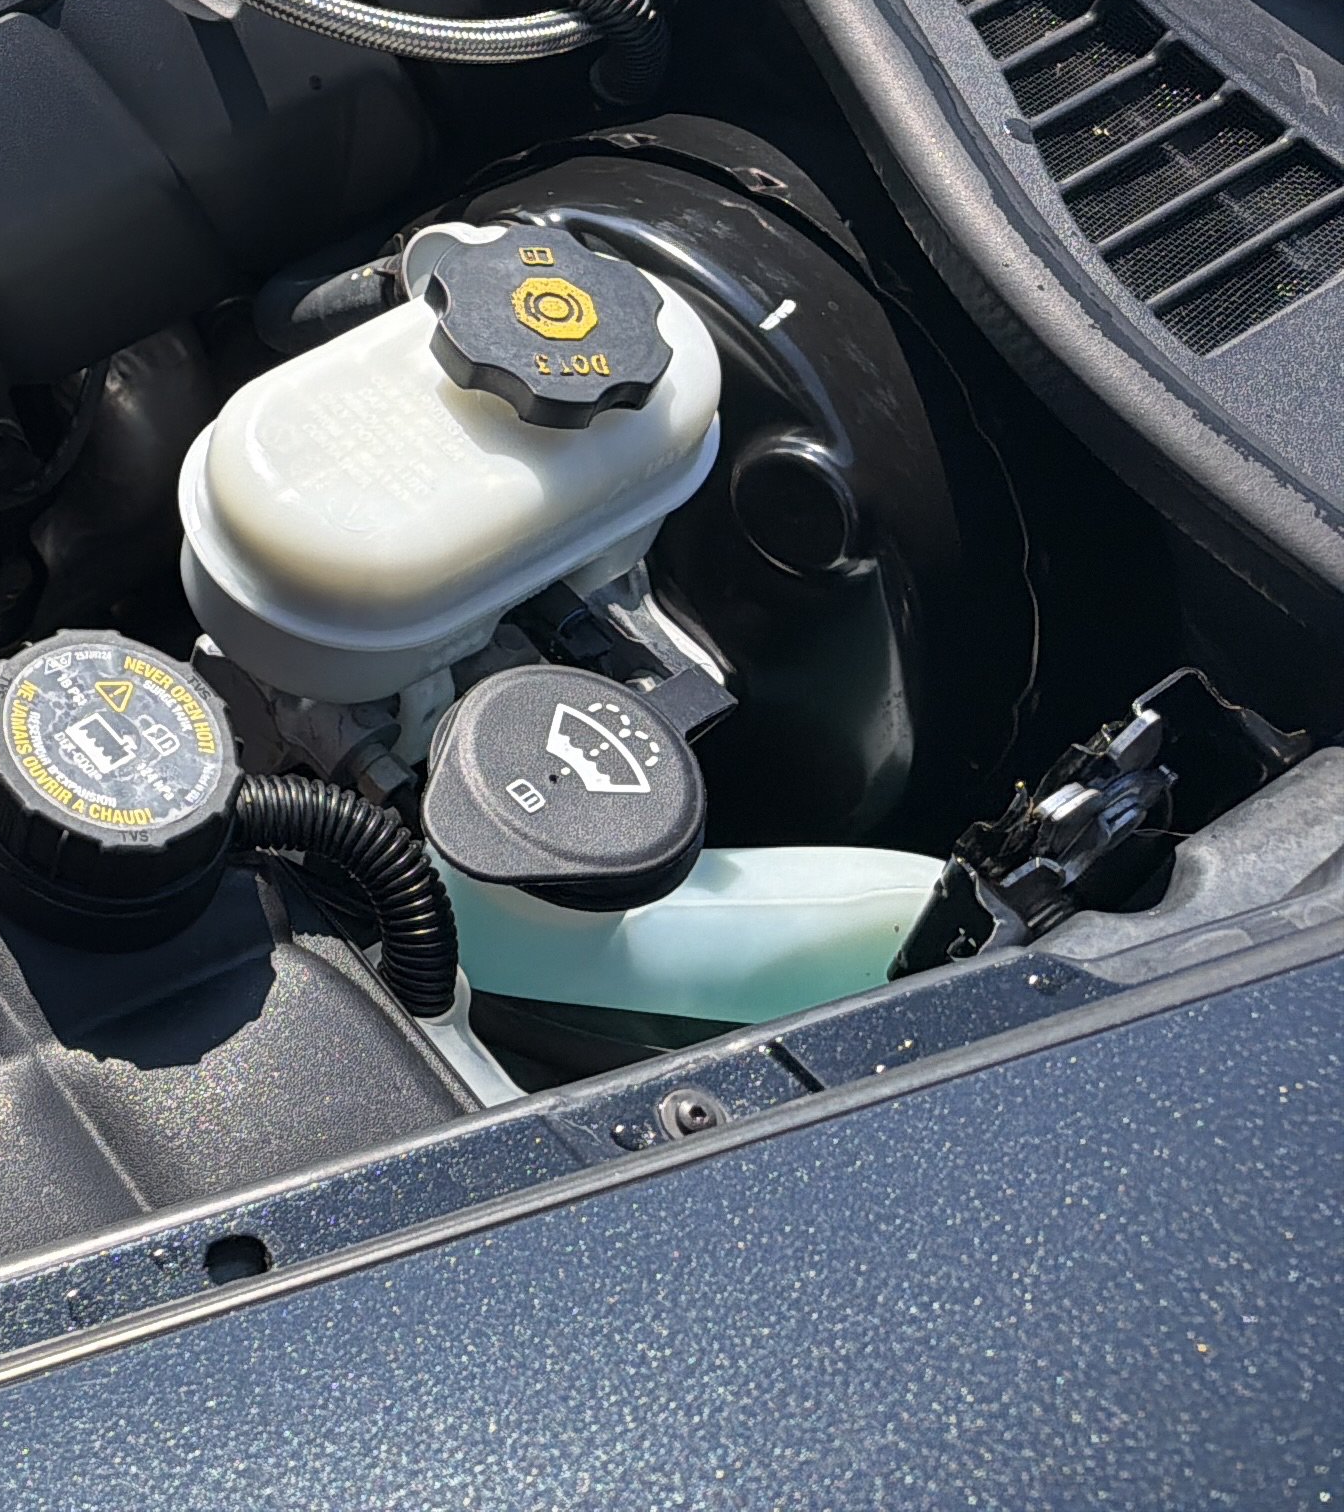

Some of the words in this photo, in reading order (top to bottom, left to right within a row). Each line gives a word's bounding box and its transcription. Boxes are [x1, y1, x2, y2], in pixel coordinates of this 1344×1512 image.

[534, 353, 553, 375] 3
[560, 353, 611, 377] DOT
[17, 680, 38, 701] NE
[188, 674, 212, 701] TVS
[124, 655, 174, 690] NEVER
[170, 685, 206, 721] OPEN
[194, 721, 216, 754] HOT!
[11, 699, 33, 754] JAMAIS
[22, 755, 73, 804] OUVRIR
[88, 803, 154, 825] CHAUD!
[117, 830, 149, 842] TVS
